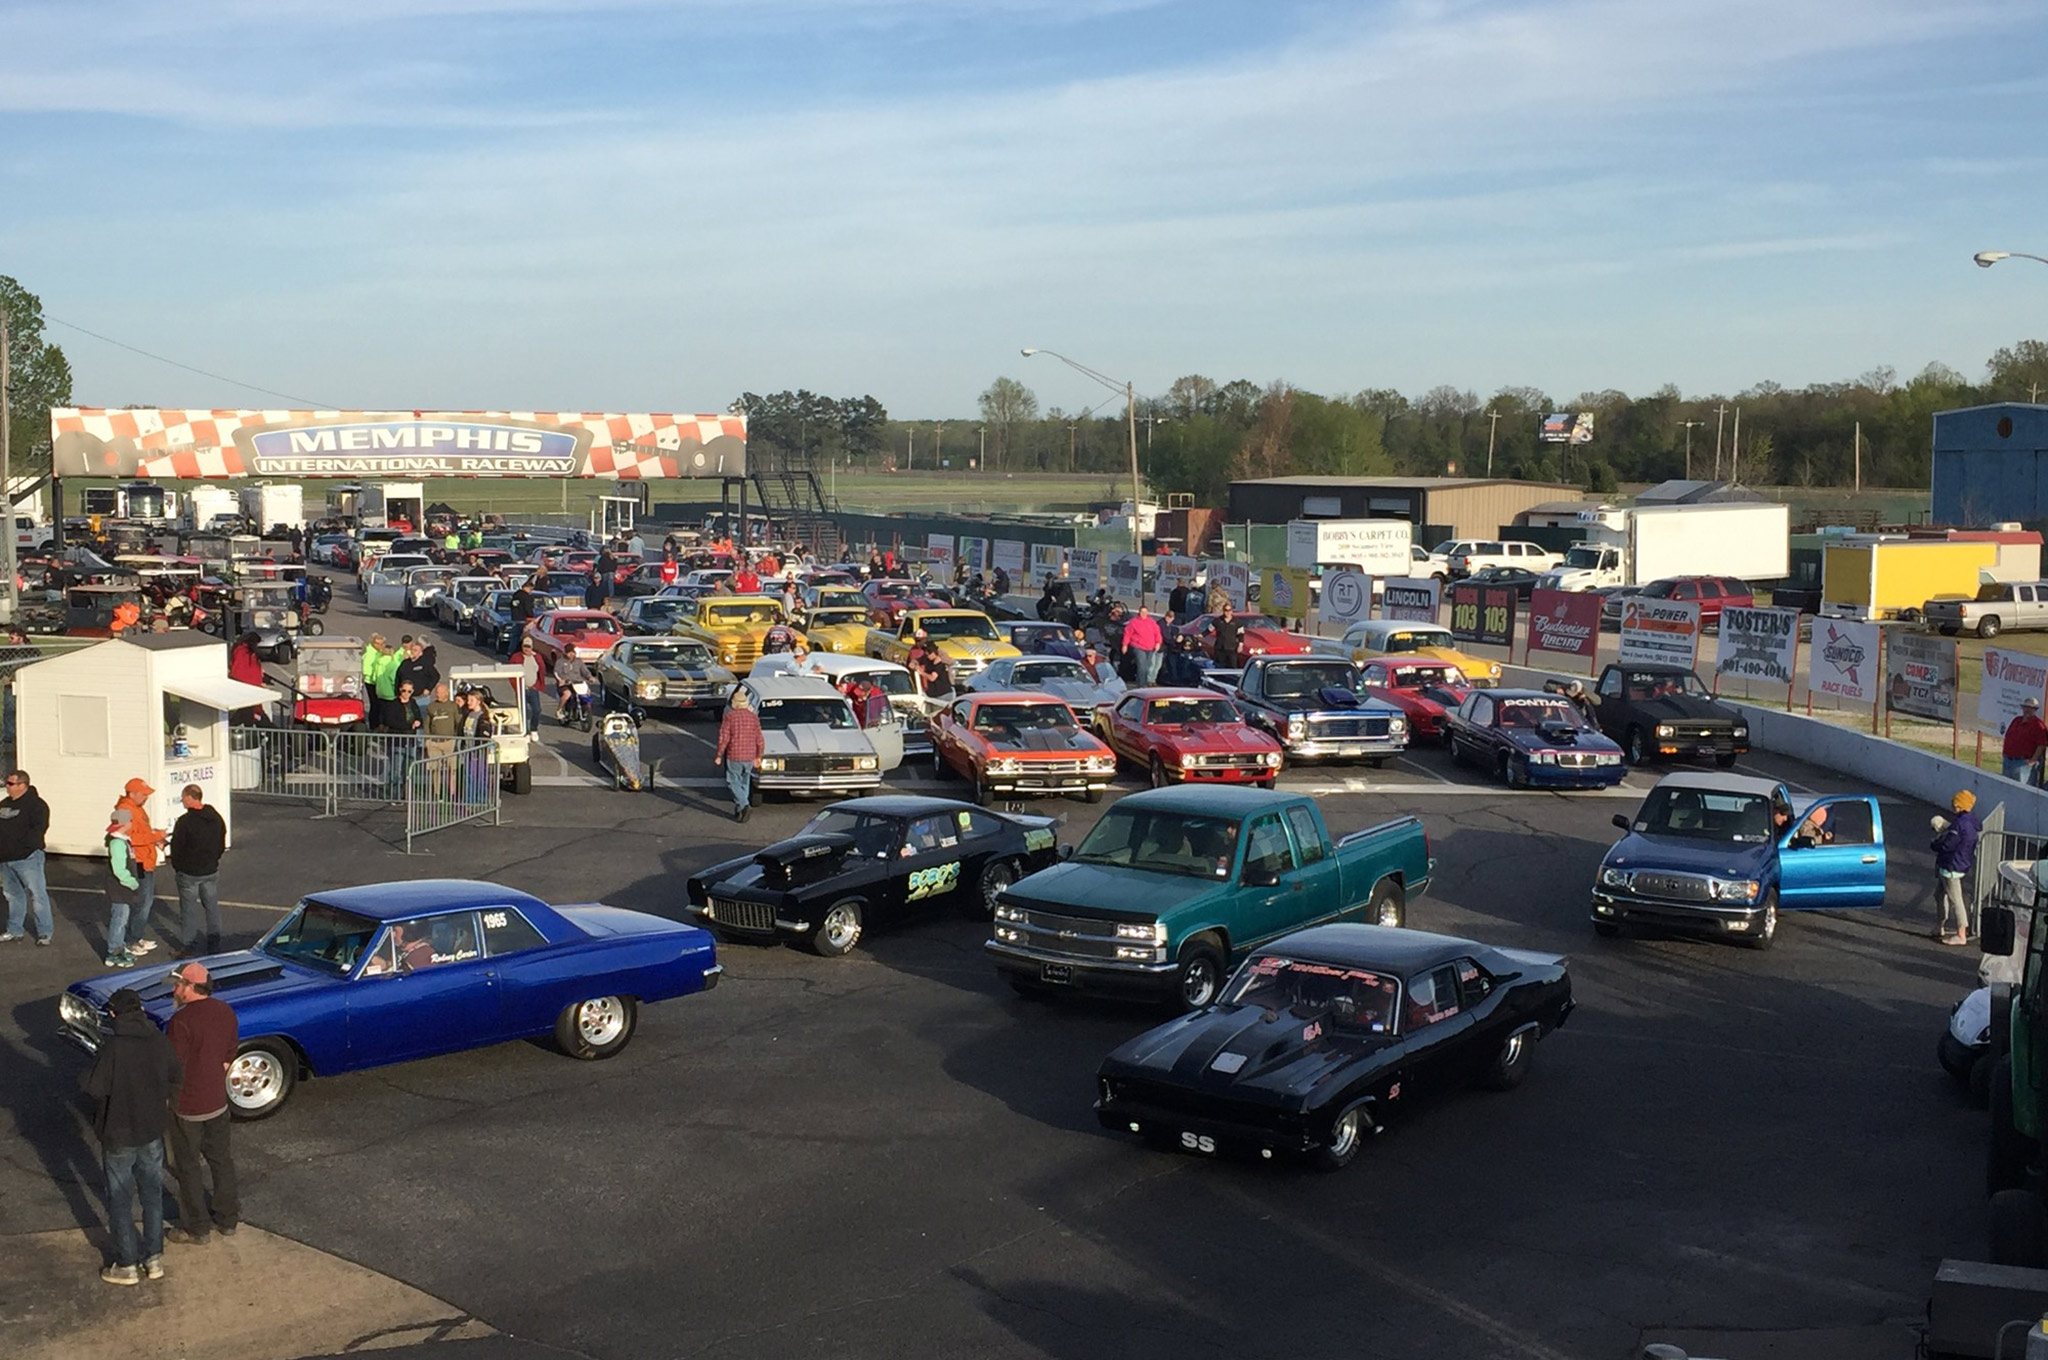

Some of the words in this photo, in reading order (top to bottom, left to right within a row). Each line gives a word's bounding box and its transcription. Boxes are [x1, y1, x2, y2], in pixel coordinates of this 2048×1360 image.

[290, 427, 544, 453] MEMPHIS
[260, 457, 453, 472] INTERNATIONAL
[461, 458, 573, 472] RACEWAY
[1385, 589, 1430, 607] LINCOLN
[1454, 604, 1478, 631] 103
[1484, 606, 1508, 634] 103
[1622, 602, 1637, 629] 2
[1652, 608, 1688, 622] POWER
[1726, 608, 1791, 636] FOSTER'S
[1534, 614, 1591, 636] Budweiser
[1825, 646, 1862, 663] SUNOCO
[1905, 663, 1929, 680] COMP
[1821, 680, 1840, 692] RACE
[1841, 684, 1863, 697] FUELS
[1504, 699, 1570, 708] PONTIAC
[170, 770, 191, 784] TRACK
[193, 766, 214, 781] RULES
[908, 861, 960, 890] BOBO'S
[483, 912, 507, 929] 1965
[1181, 1131, 1215, 1152] SS
